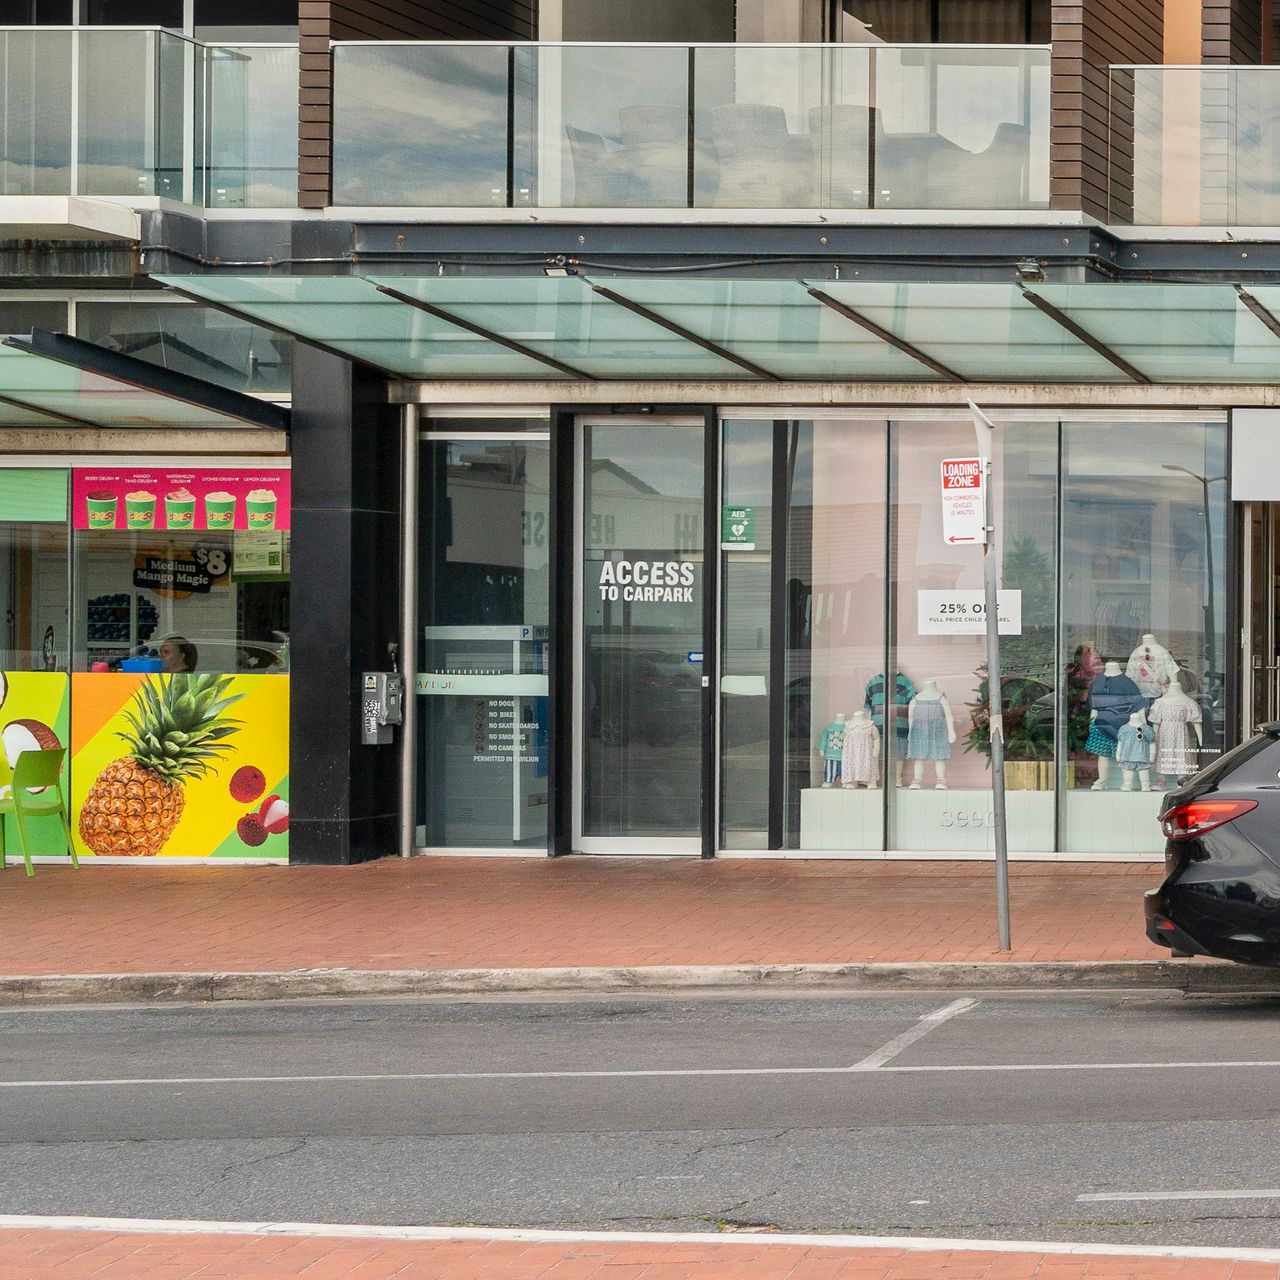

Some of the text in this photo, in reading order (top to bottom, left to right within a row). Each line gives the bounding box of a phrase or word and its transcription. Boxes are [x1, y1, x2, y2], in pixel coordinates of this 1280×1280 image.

[943, 462, 979, 477] LOADING
[948, 476, 975, 488] ZONE
[150, 560, 196, 573] Medium
[196, 548, 227, 575] $8
[137, 570, 209, 586] Mango Magic
[600, 560, 695, 586] ACCESS
[599, 585, 694, 603] TO CARPARK
[940, 603, 967, 614] 25%
[523, 628, 530, 638] P
